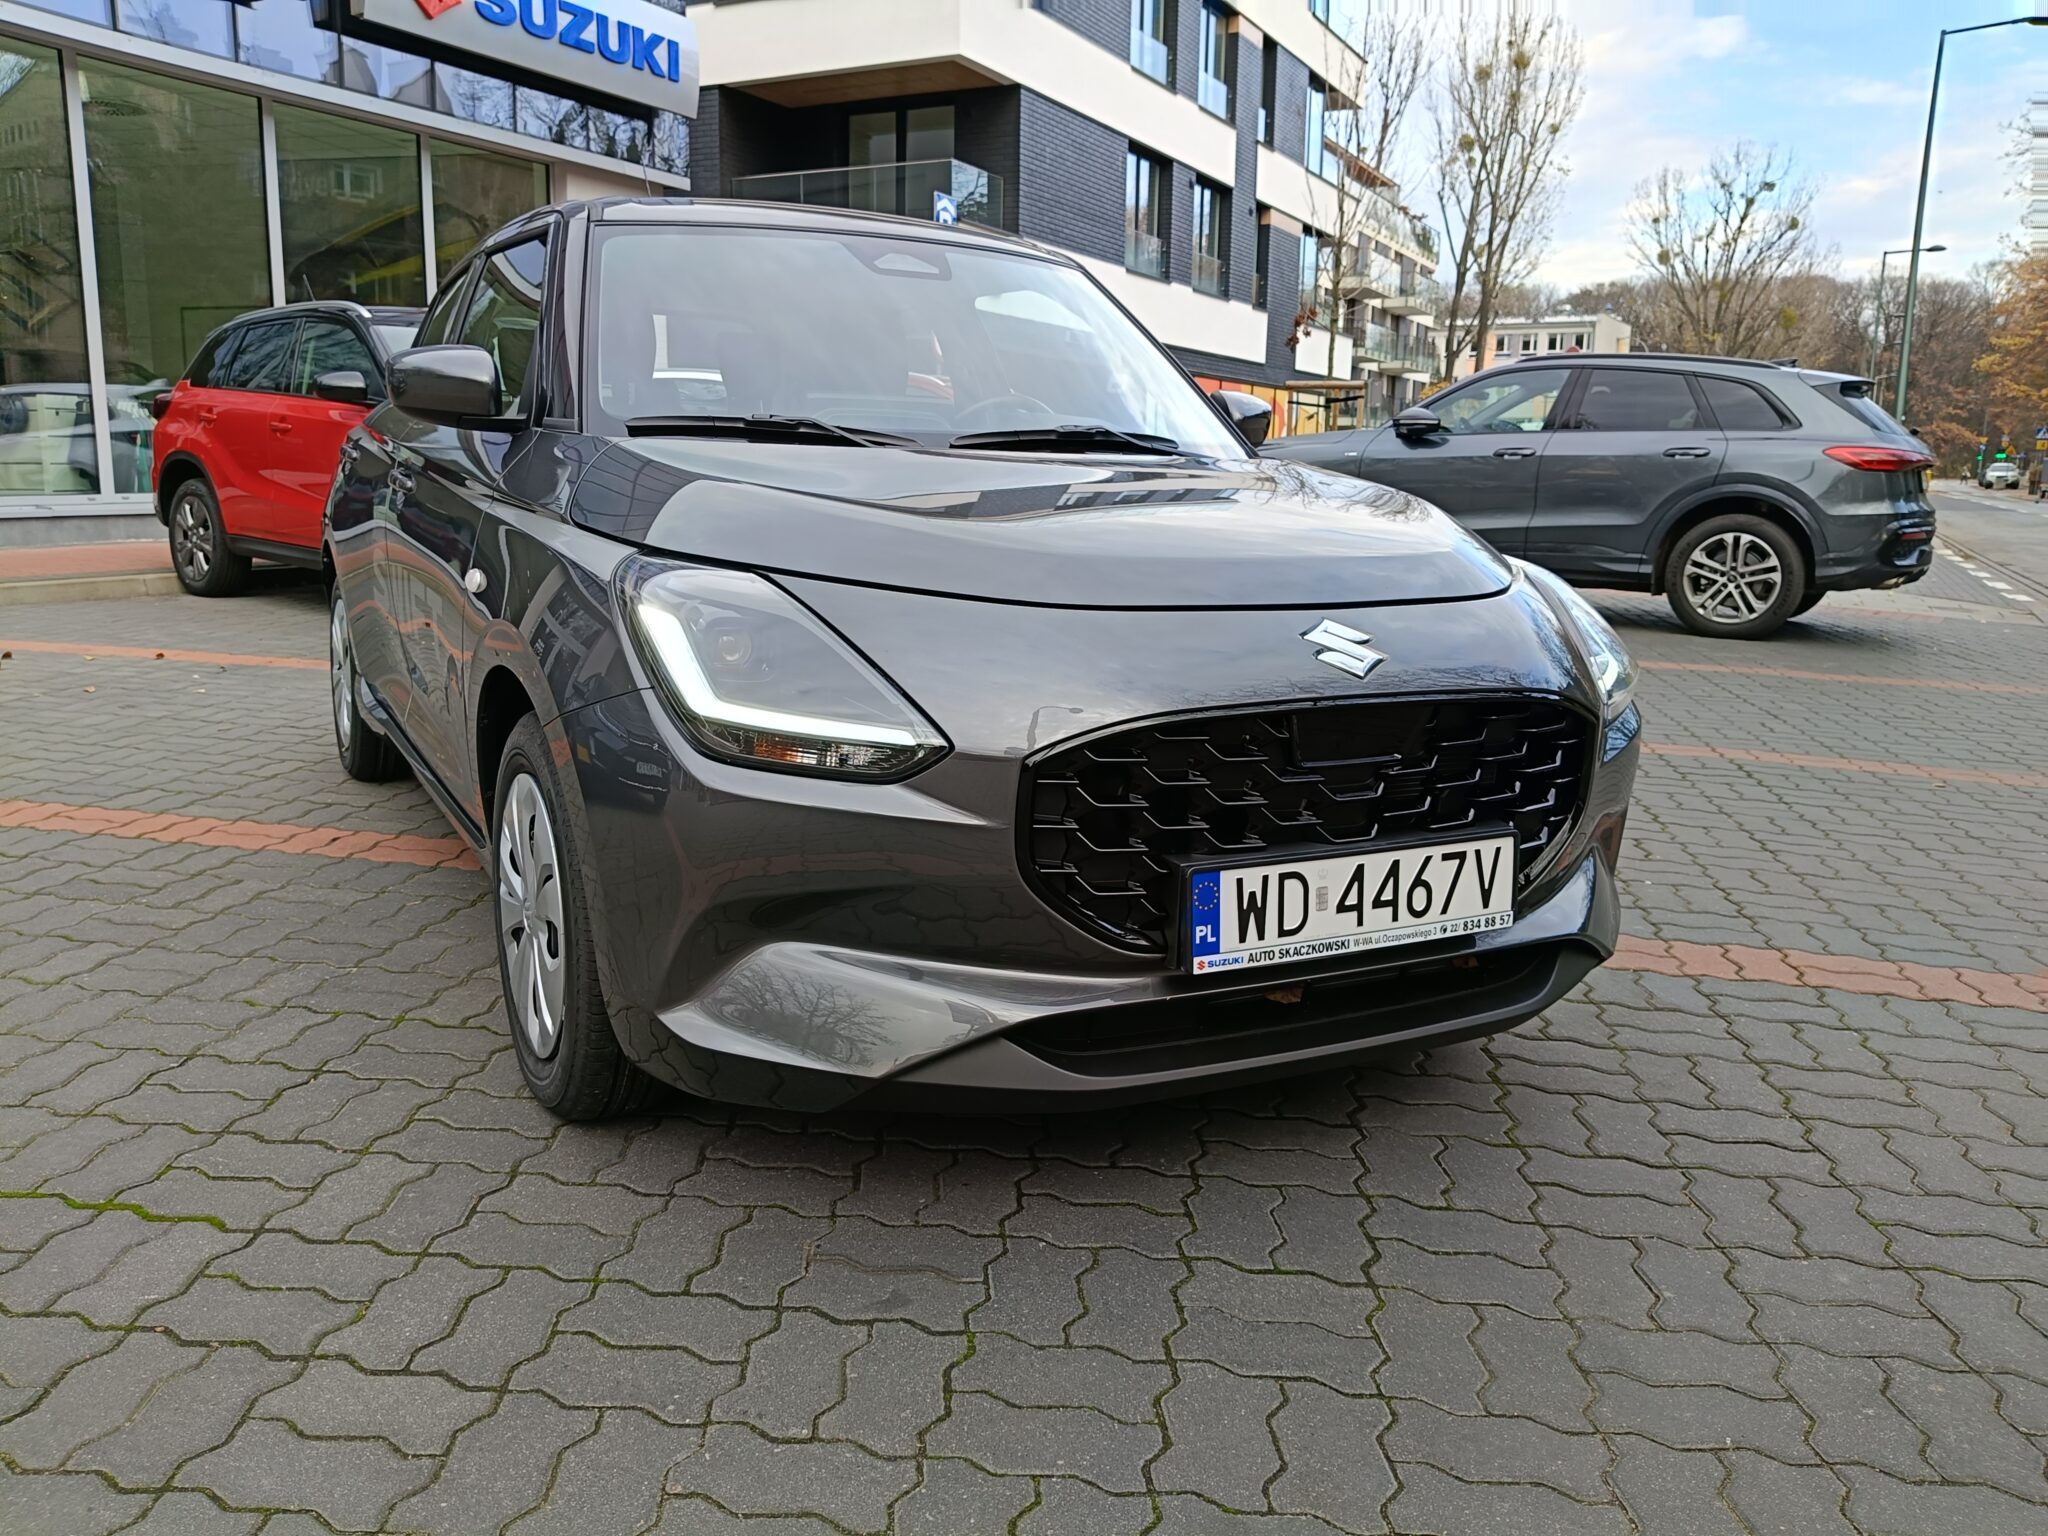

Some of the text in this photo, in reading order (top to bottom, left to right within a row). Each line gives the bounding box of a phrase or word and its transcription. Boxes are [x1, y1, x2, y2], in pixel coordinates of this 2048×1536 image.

[1236, 846, 1501, 944] WD 4467V
[1195, 925, 1216, 944] PL
[1208, 957, 1243, 968] SUZUKI
[1248, 950, 1275, 964] AUTO
[1278, 939, 1350, 959] SKACZKOWSKI
[1353, 938, 1373, 947] W-WA
[1433, 926, 1438, 935] 3
[1463, 920, 1481, 931] 834
[1484, 916, 1496, 928] 88
[1499, 914, 1511, 925] 57
